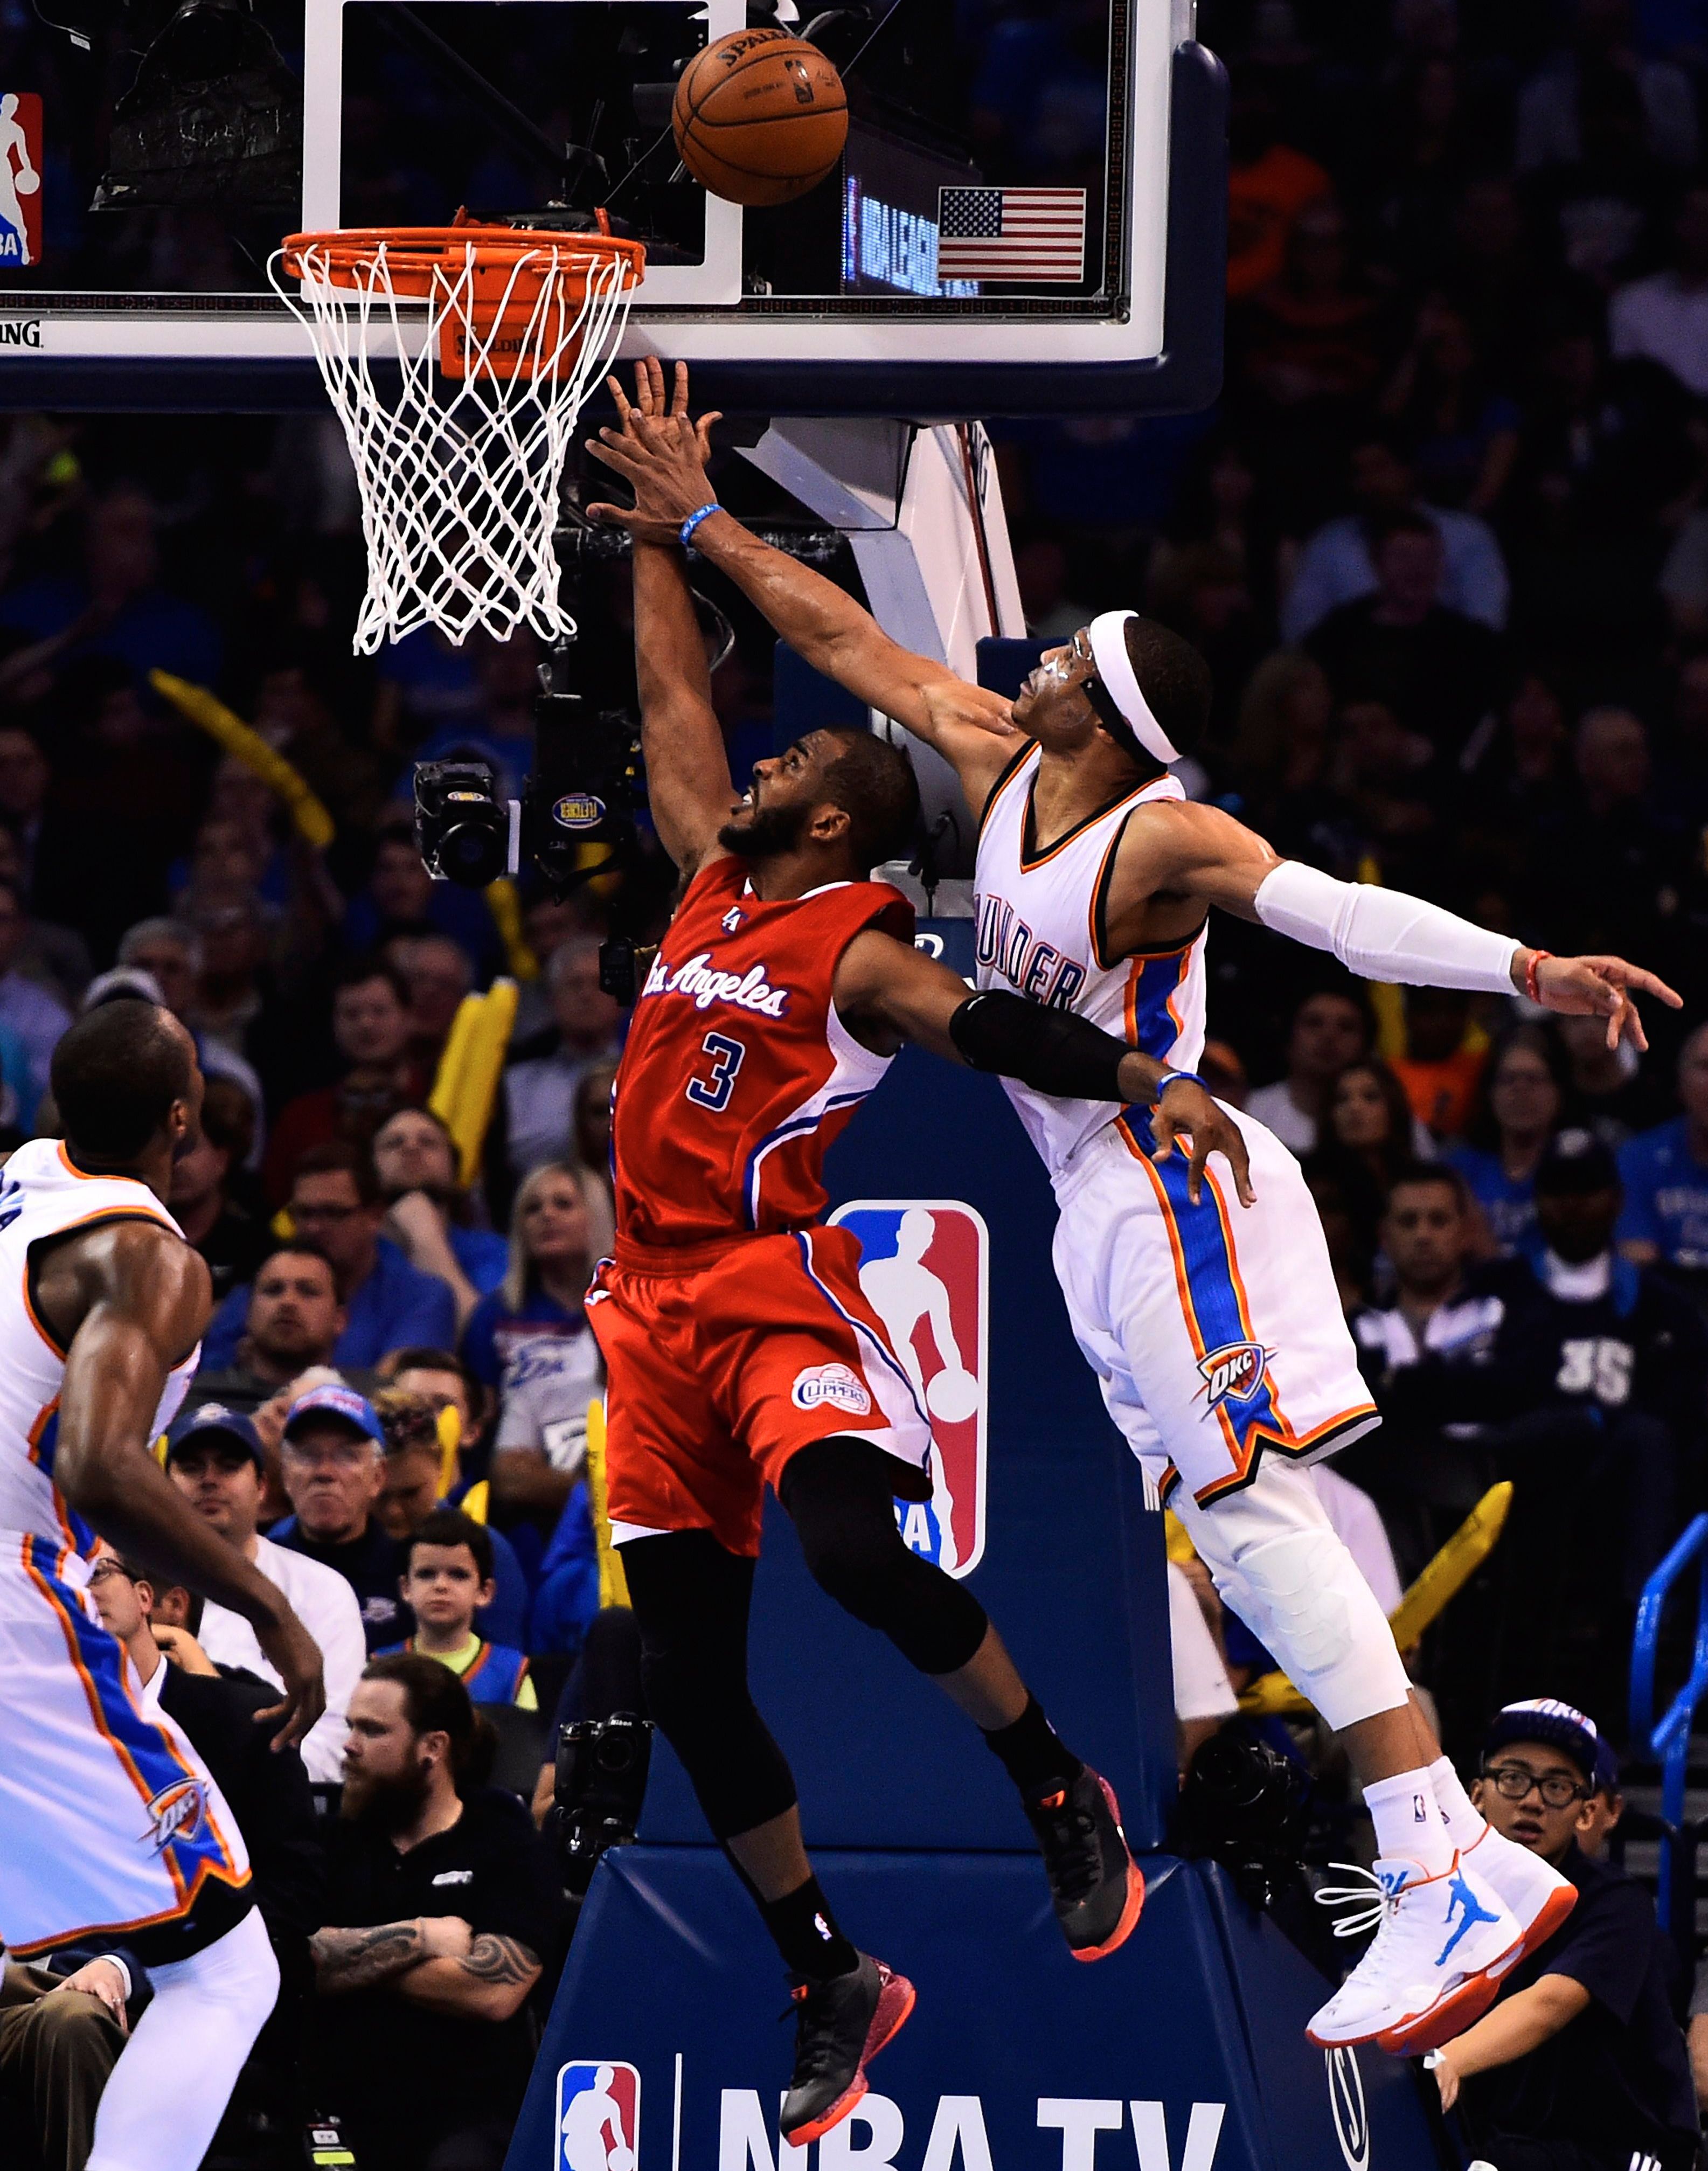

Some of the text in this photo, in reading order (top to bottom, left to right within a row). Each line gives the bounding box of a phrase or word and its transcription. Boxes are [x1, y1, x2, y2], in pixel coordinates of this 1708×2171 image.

[666, 954, 787, 1016] Angeles
[685, 1031, 746, 1112] 3
[797, 1378, 865, 1405] CLIPPERS
[1209, 1350, 1253, 1403] OKC
[719, 2089, 1226, 2171] NBA TV
